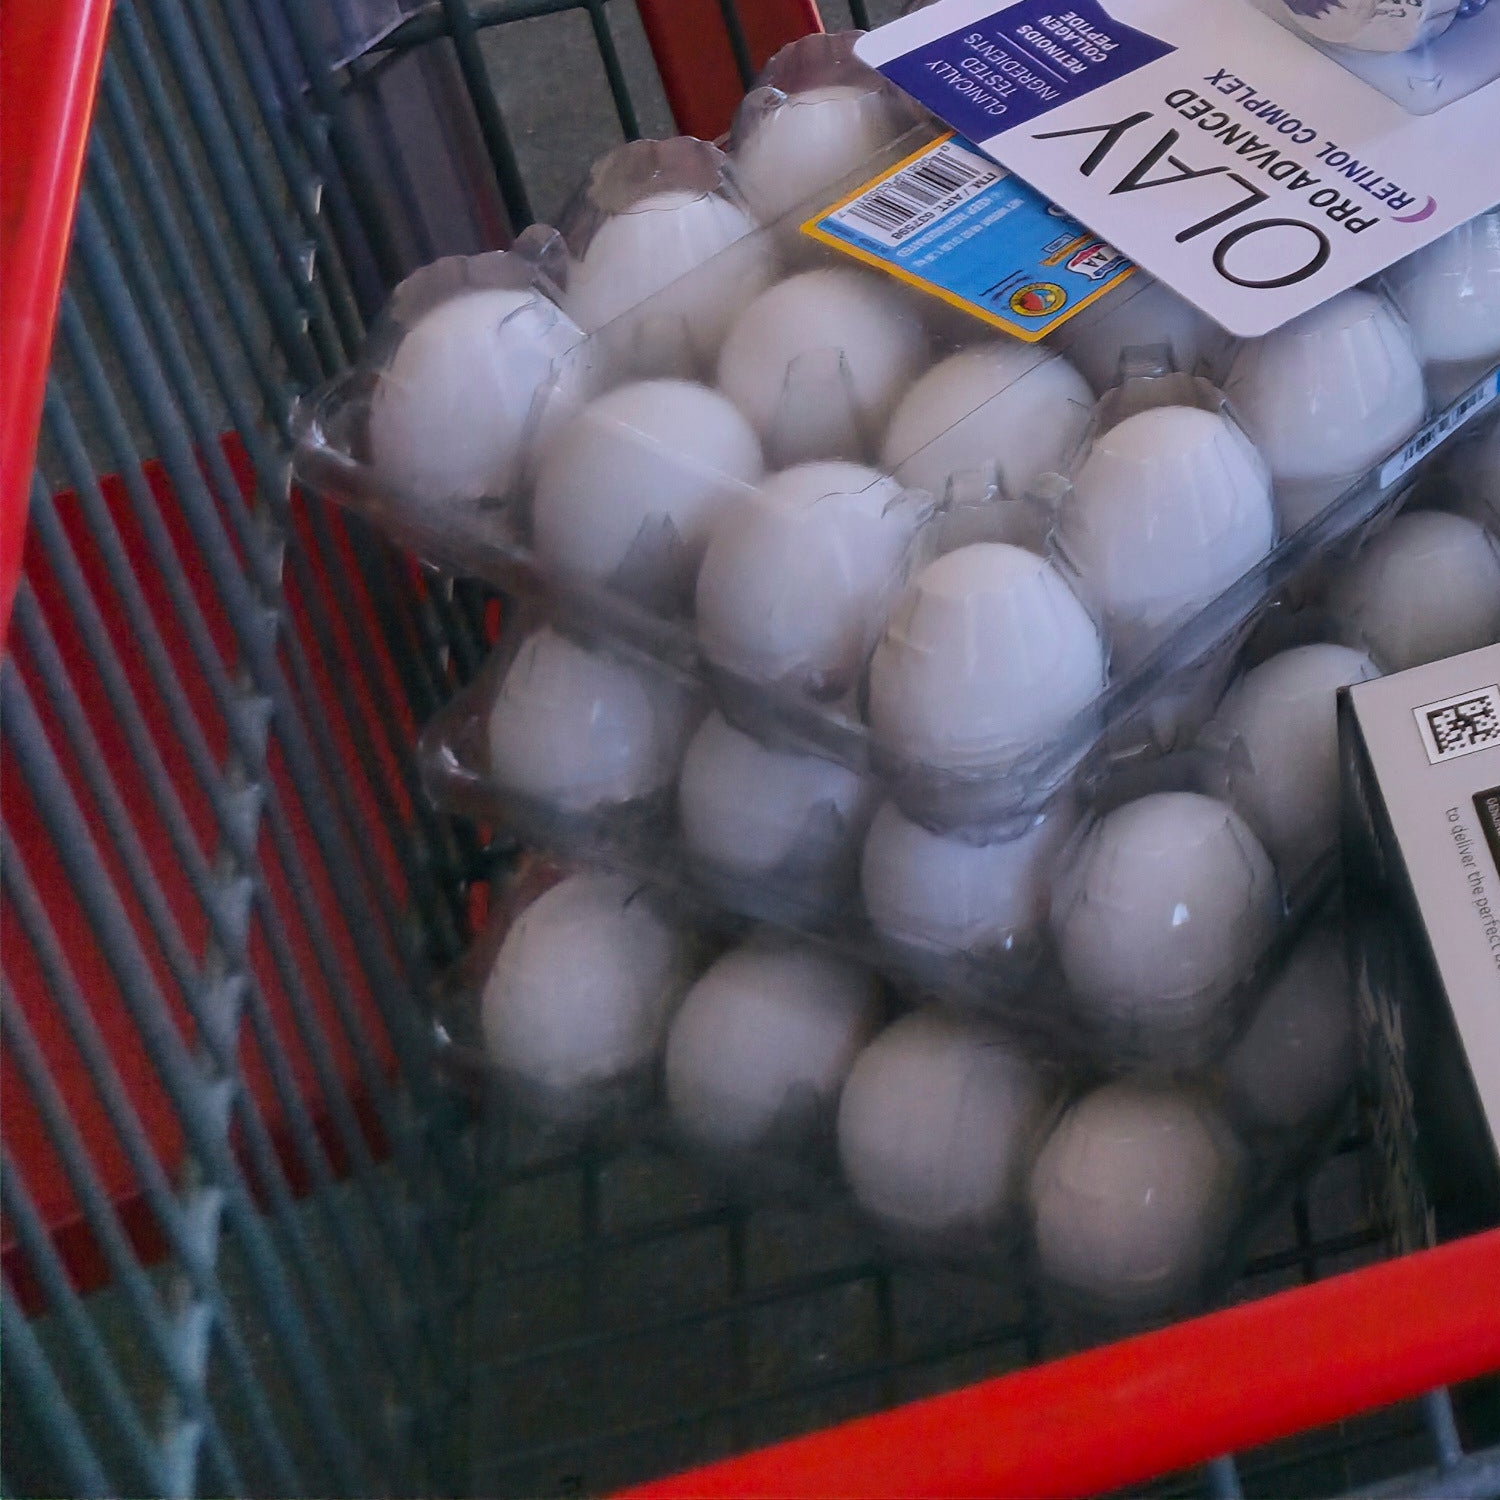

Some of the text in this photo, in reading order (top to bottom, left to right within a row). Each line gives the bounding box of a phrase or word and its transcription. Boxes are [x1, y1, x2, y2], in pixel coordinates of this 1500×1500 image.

[1015, 23, 1088, 74] RETINOIDS
[1037, 13, 1108, 63] COLLAGEN
[1058, 10, 1120, 51] PEPTIDE
[924, 58, 1008, 115] CLINICALLY
[959, 56, 1018, 98] TESTED
[962, 31, 1061, 101] INGREDIENTS
[1163, 87, 1381, 235] PRO ADVANCED
[1202, 67, 1416, 211] RETINOL COMPLEX
[1029, 61, 1331, 290] OLAY
